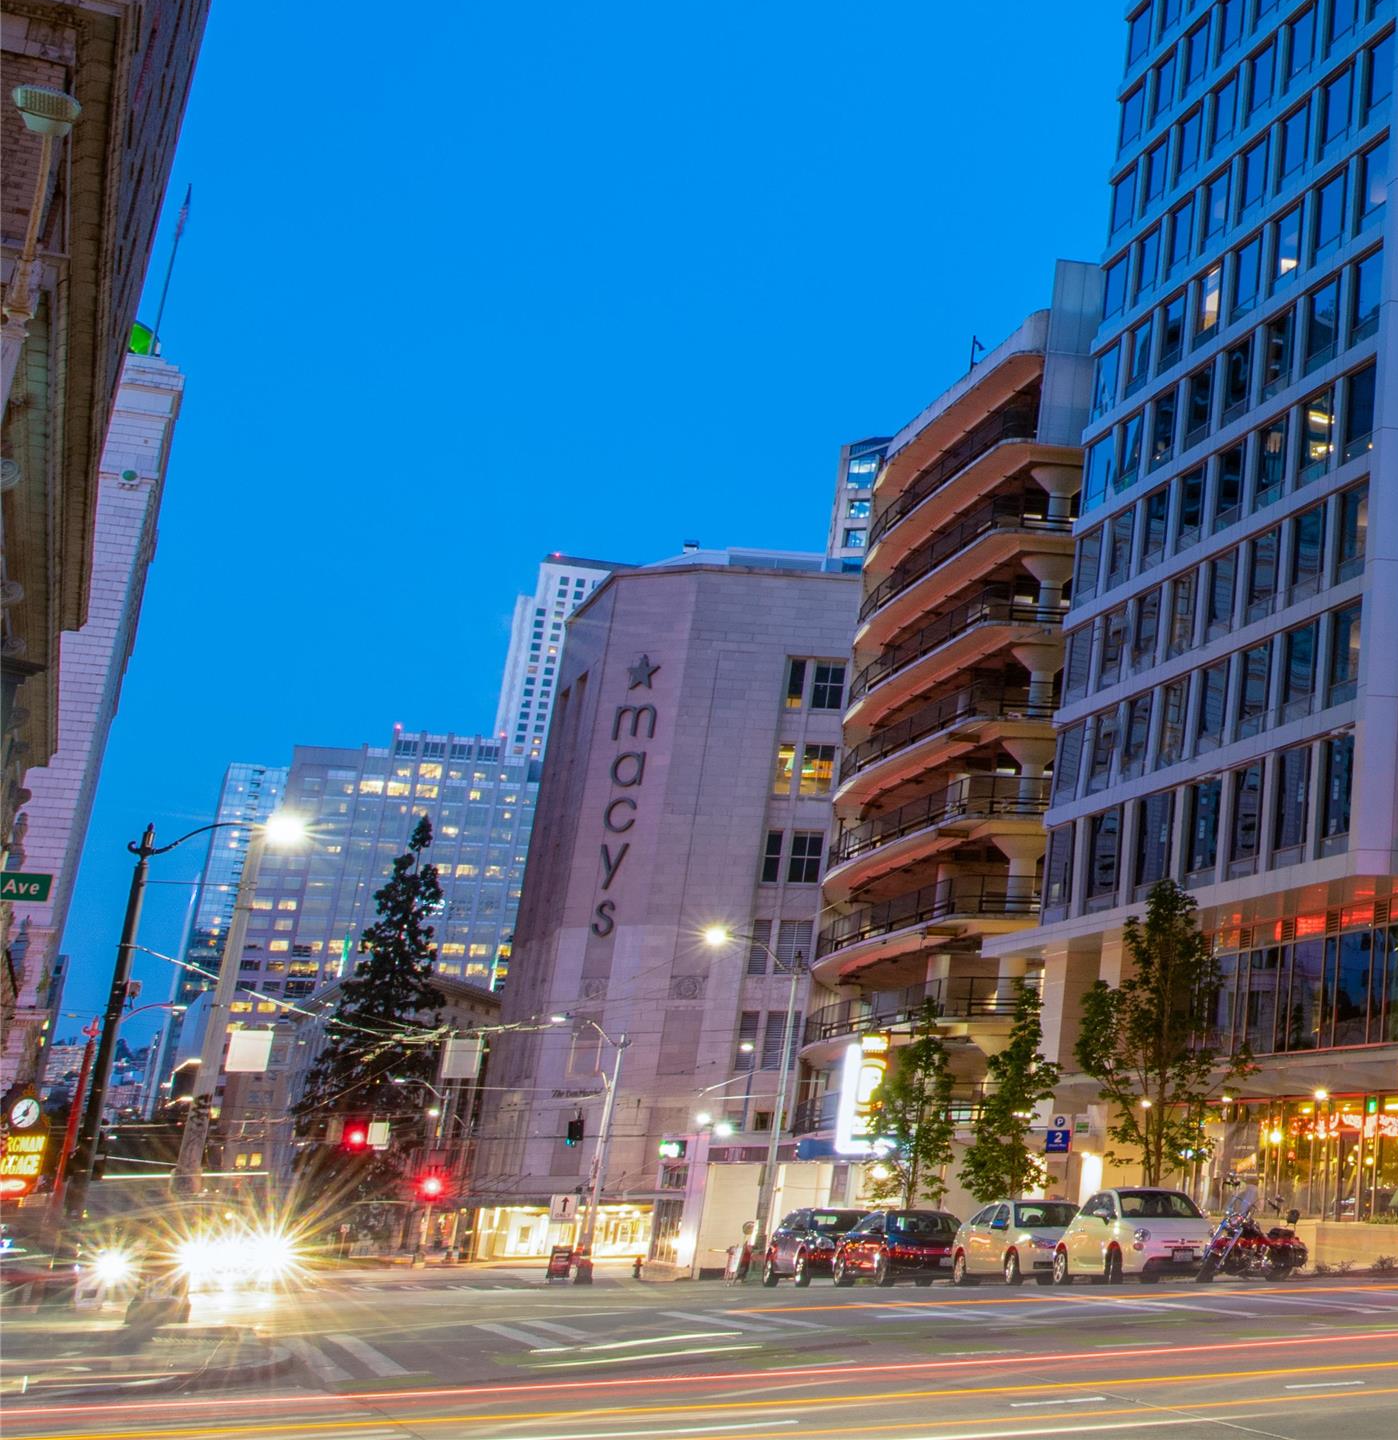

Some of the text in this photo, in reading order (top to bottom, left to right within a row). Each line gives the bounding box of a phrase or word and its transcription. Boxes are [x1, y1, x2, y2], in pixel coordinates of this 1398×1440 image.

[592, 703, 658, 938] macys
[1, 878, 40, 895] Ave
[1053, 1131, 1063, 1143] 2
